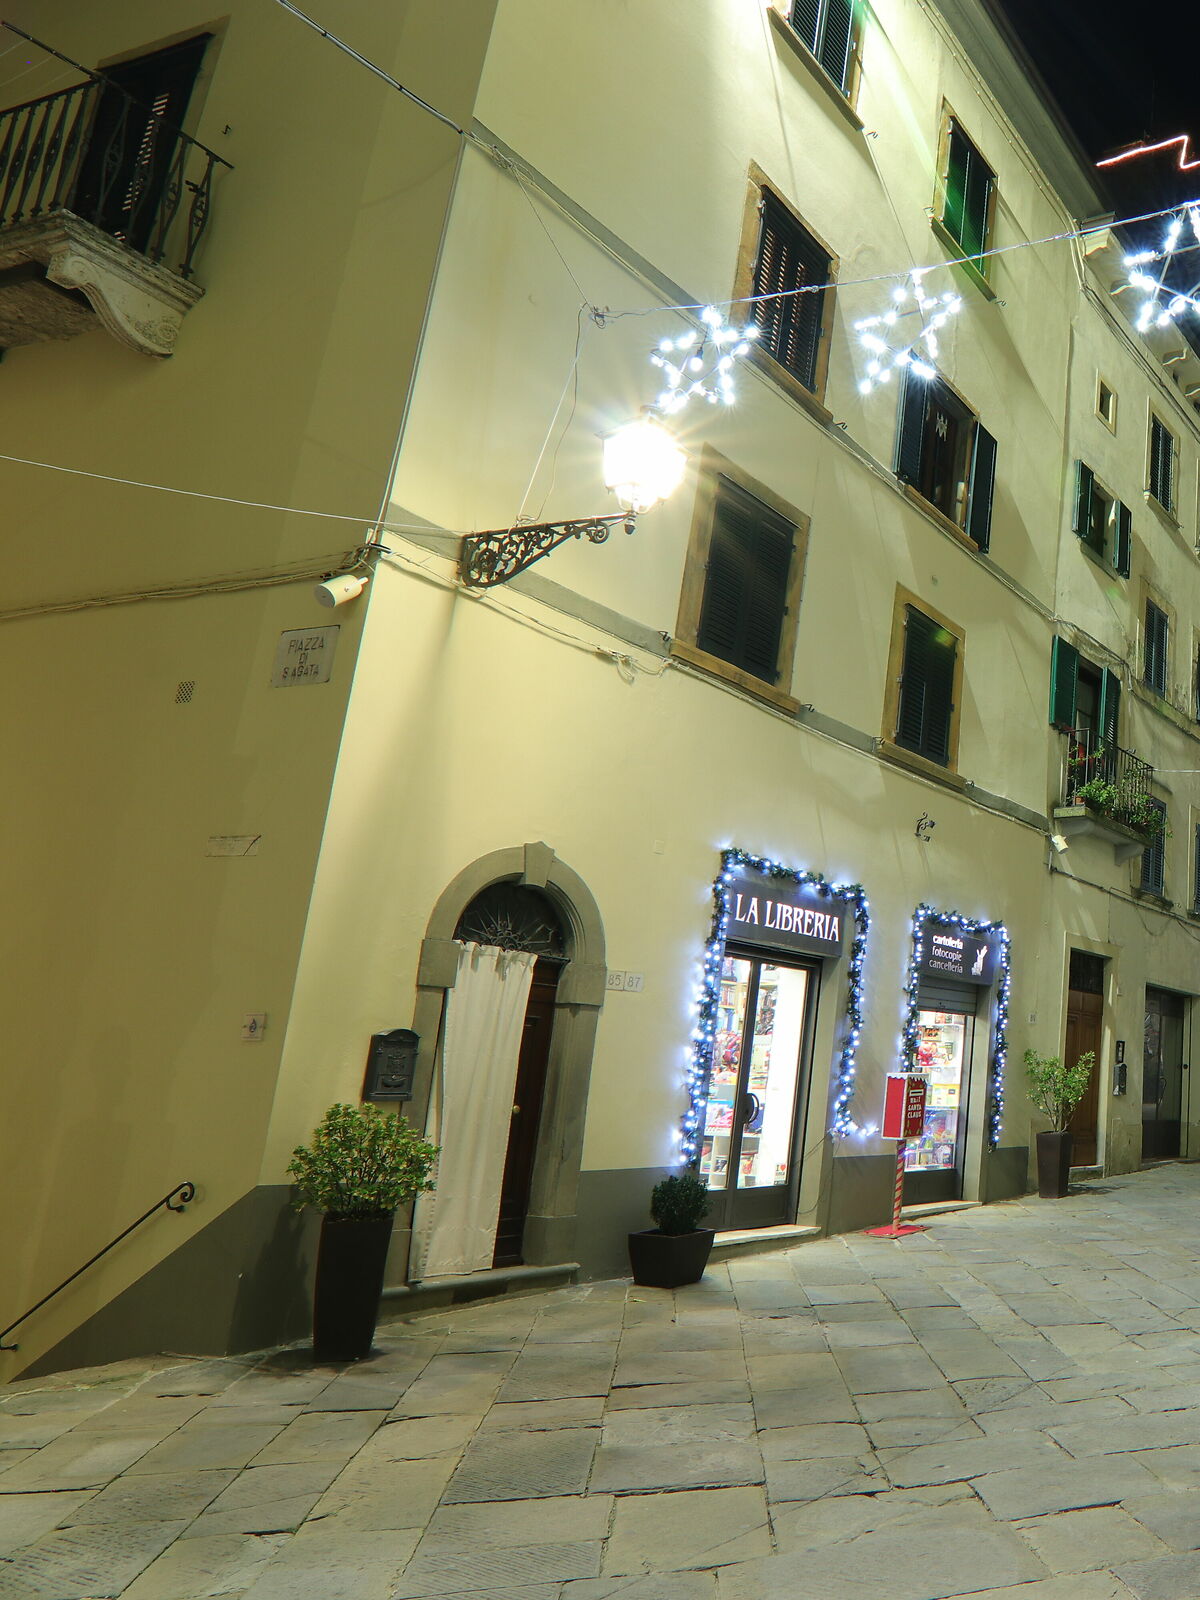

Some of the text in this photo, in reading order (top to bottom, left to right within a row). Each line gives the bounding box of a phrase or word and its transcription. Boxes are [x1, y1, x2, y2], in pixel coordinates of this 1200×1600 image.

[287, 636, 324, 654] PIAZZA
[299, 652, 308, 665] DI
[290, 664, 319, 679] AGATA
[735, 893, 840, 942] LA LIBRERIA
[932, 934, 964, 949] cartoleria
[931, 945, 962, 961] fotocopie
[928, 959, 963, 974] cancelleria
[608, 974, 622, 986] 85
[627, 976, 641, 989] 87
